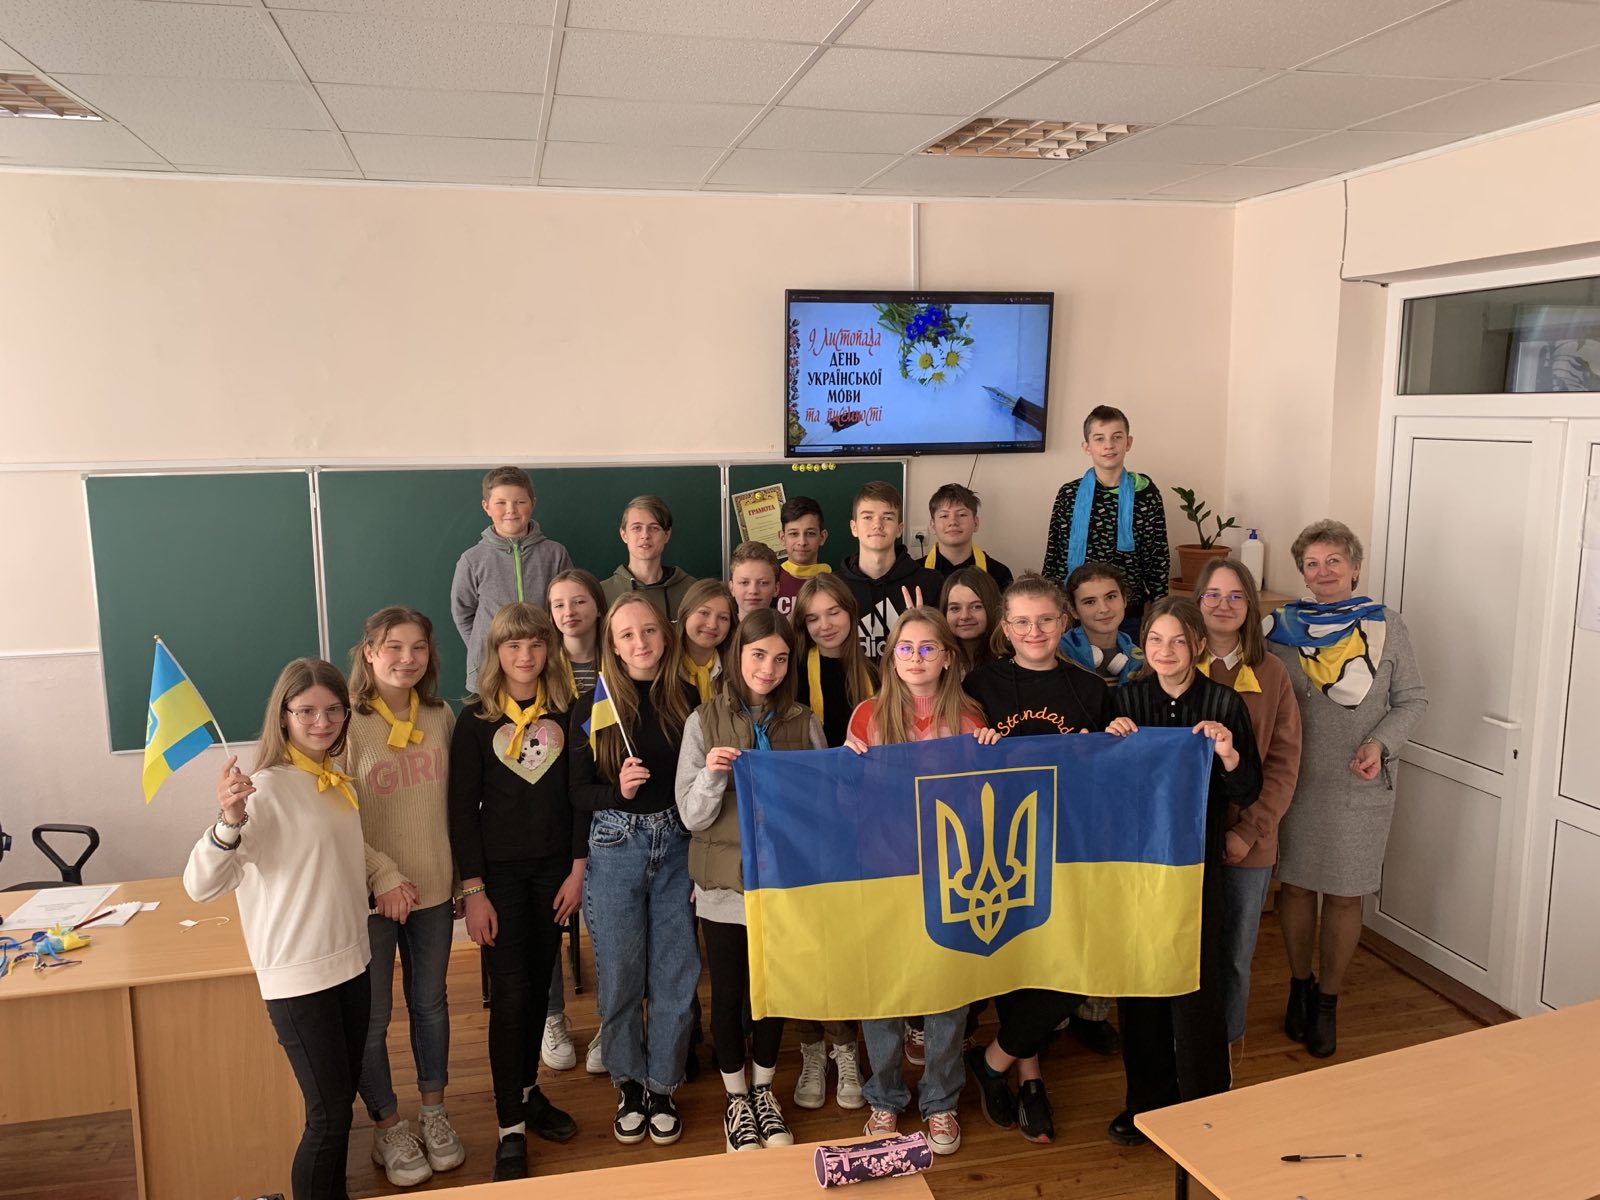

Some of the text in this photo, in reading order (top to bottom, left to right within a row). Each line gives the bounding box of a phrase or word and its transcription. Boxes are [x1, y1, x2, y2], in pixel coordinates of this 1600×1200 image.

[809, 328, 816, 351] 9
[830, 352, 860, 367] ДЕНЬ
[807, 369, 882, 385] УКРАЇНСЬКОЇ
[827, 388, 860, 403] МОВИ
[805, 408, 820, 422] та
[748, 504, 775, 516] ГРАМОТА
[997, 706, 1074, 736] Standard
